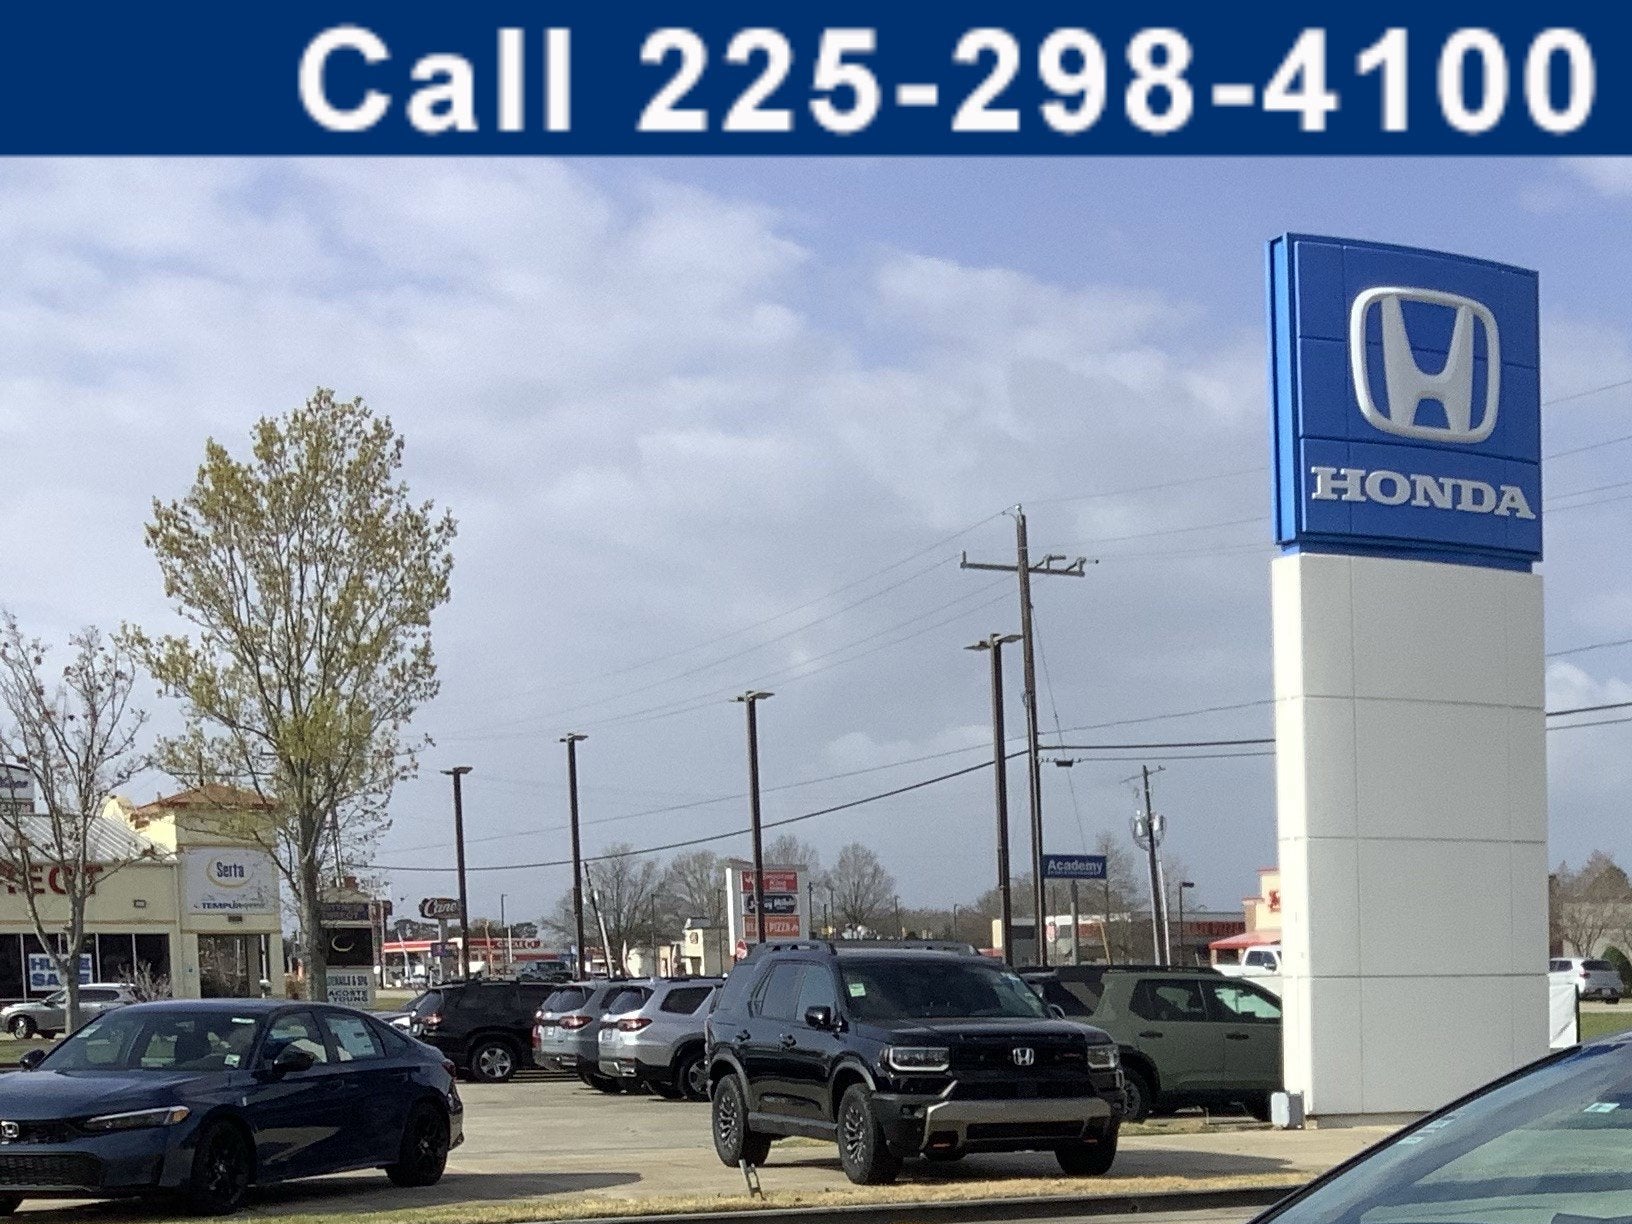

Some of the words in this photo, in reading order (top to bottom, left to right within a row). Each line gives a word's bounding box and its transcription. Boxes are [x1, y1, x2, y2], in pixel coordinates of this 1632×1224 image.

[1311, 466, 1536, 519] HONDA
[216, 861, 245, 878] Serta
[1047, 860, 1103, 875] Academy
[423, 900, 460, 917] Cane
[30, 957, 90, 971] HUE
[31, 972, 91, 986] SAE
